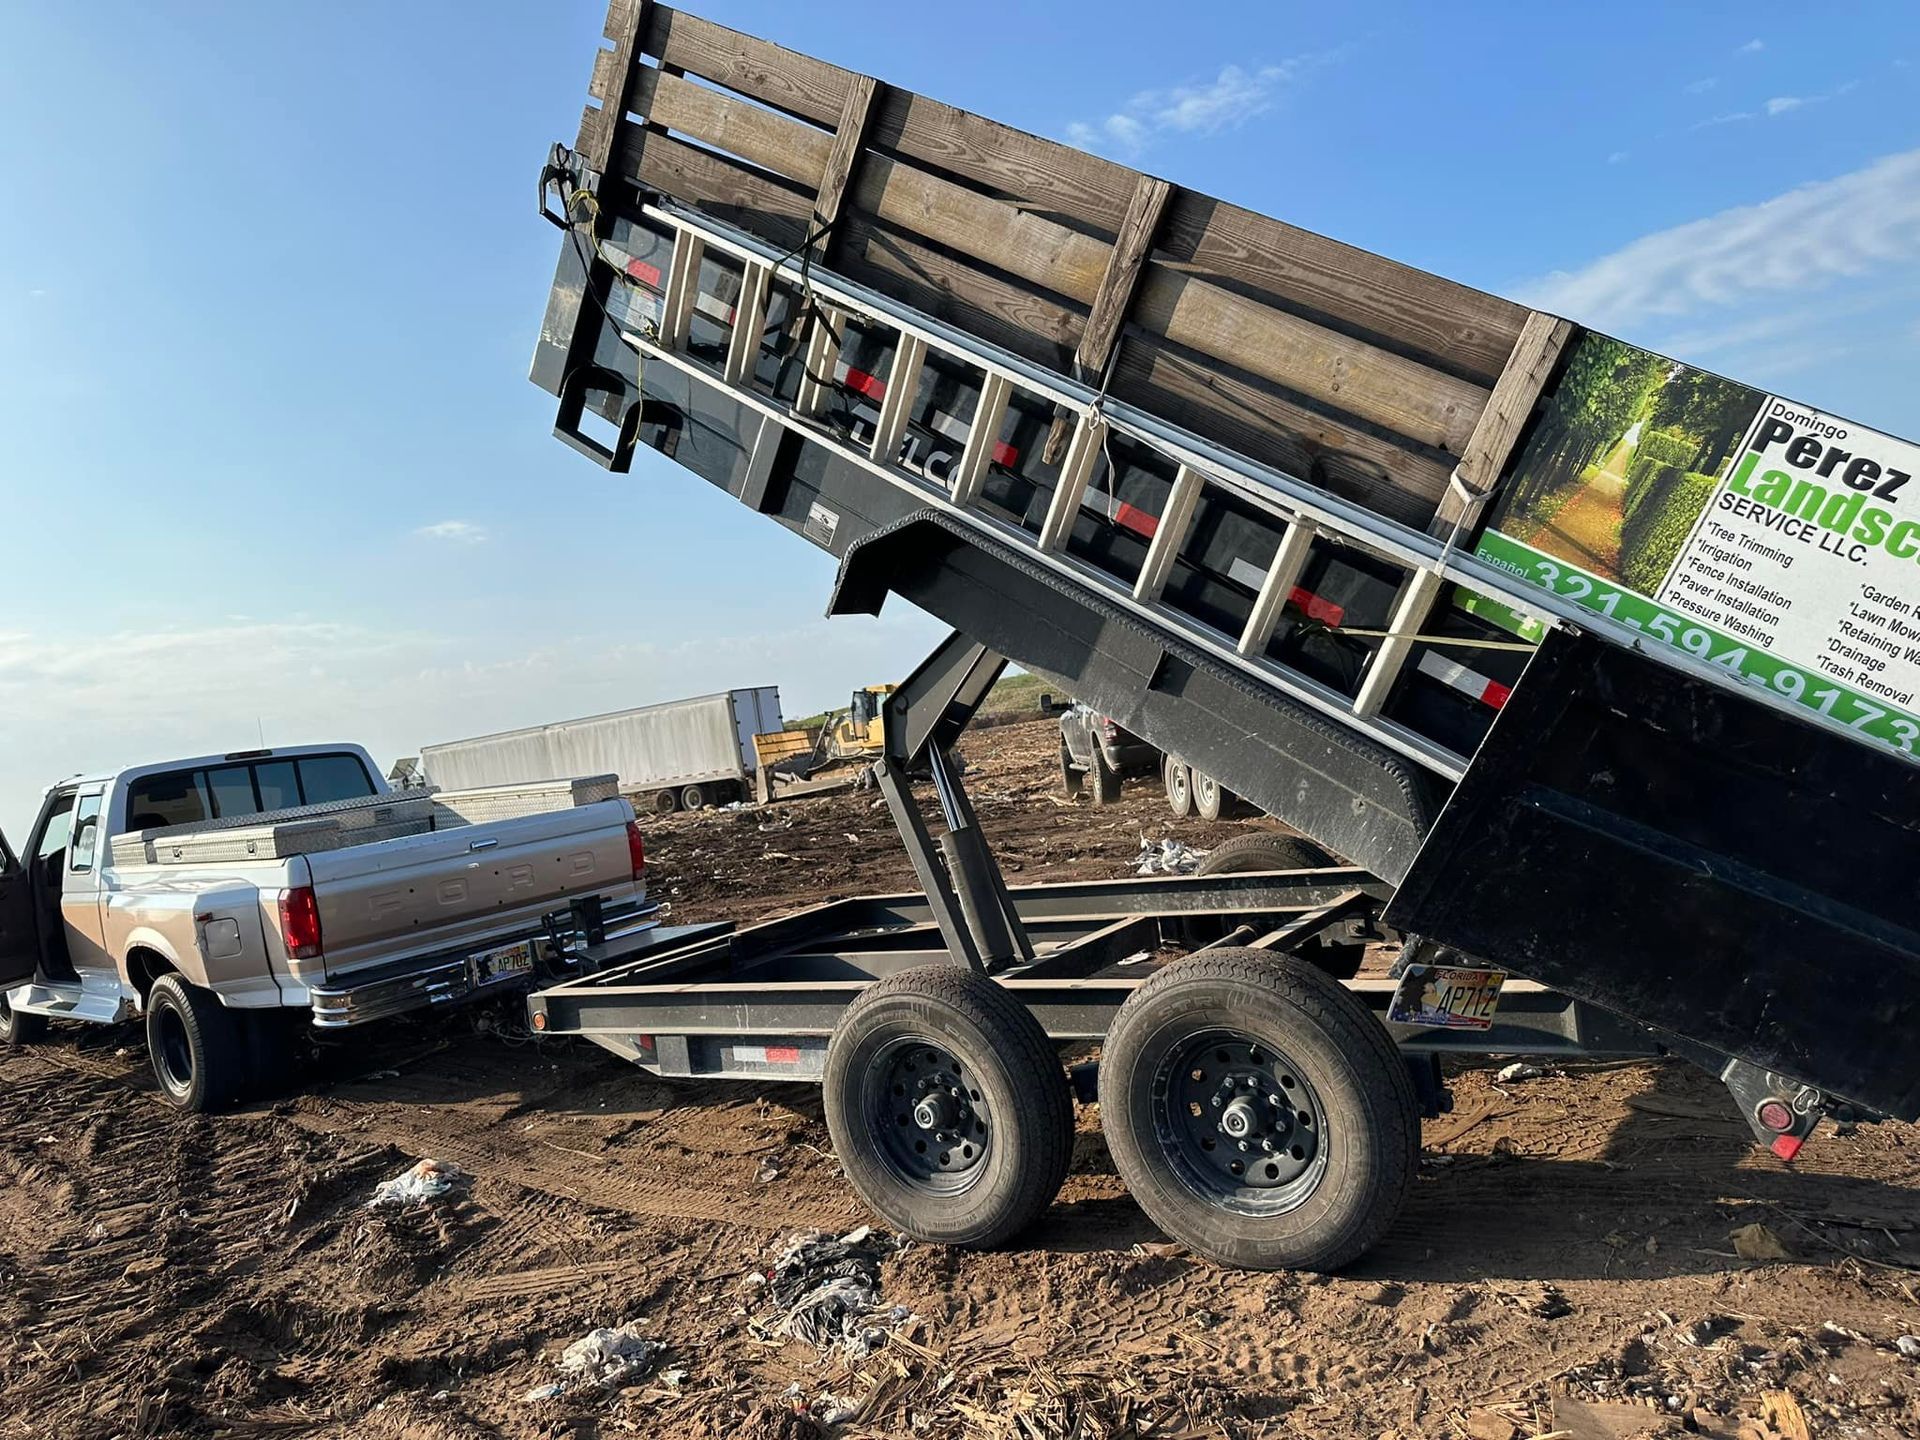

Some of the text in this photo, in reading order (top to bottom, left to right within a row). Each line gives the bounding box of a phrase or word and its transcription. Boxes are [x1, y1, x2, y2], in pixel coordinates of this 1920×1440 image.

[1770, 403, 1848, 440] Domingo
[1750, 416, 1912, 504] Pérez
[1727, 452, 1920, 566] Landsc
[1718, 493, 1868, 567] SERVICE LLC.
[1738, 533, 1794, 569] Trimming
[1713, 589, 1780, 627] Installation
[1726, 572, 1793, 610] Installation
[1723, 613, 1775, 648] Washing
[1476, 548, 1529, 578] Español
[1525, 561, 1920, 754] 321-594-9173
[1855, 672, 1915, 705] Removal
[368, 850, 595, 921] FORD
